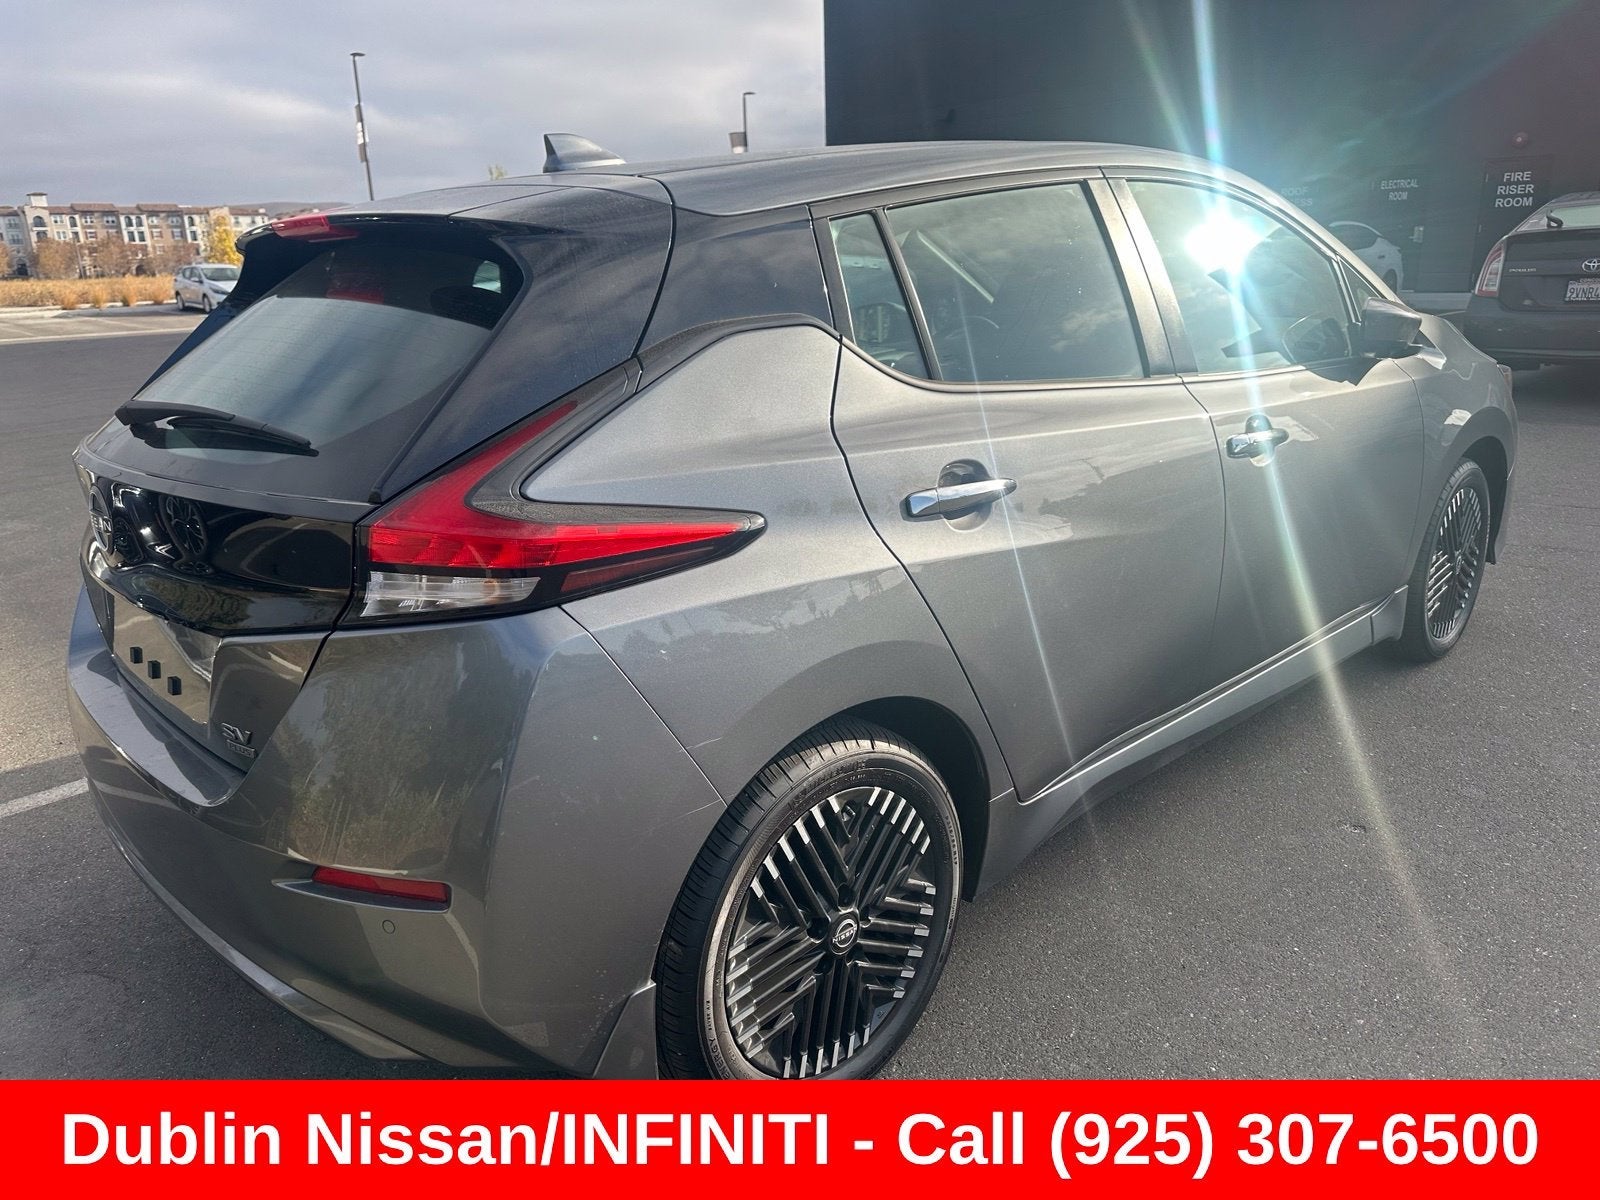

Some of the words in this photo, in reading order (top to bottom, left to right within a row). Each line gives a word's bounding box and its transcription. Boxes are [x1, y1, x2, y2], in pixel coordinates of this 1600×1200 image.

[1503, 171, 1532, 182] FIRE
[1380, 179, 1419, 190] ELECTRICAL
[1496, 184, 1535, 195] RISER
[1388, 191, 1408, 201] ROOM
[1494, 196, 1533, 208] ROOM
[221, 722, 251, 746] SV
